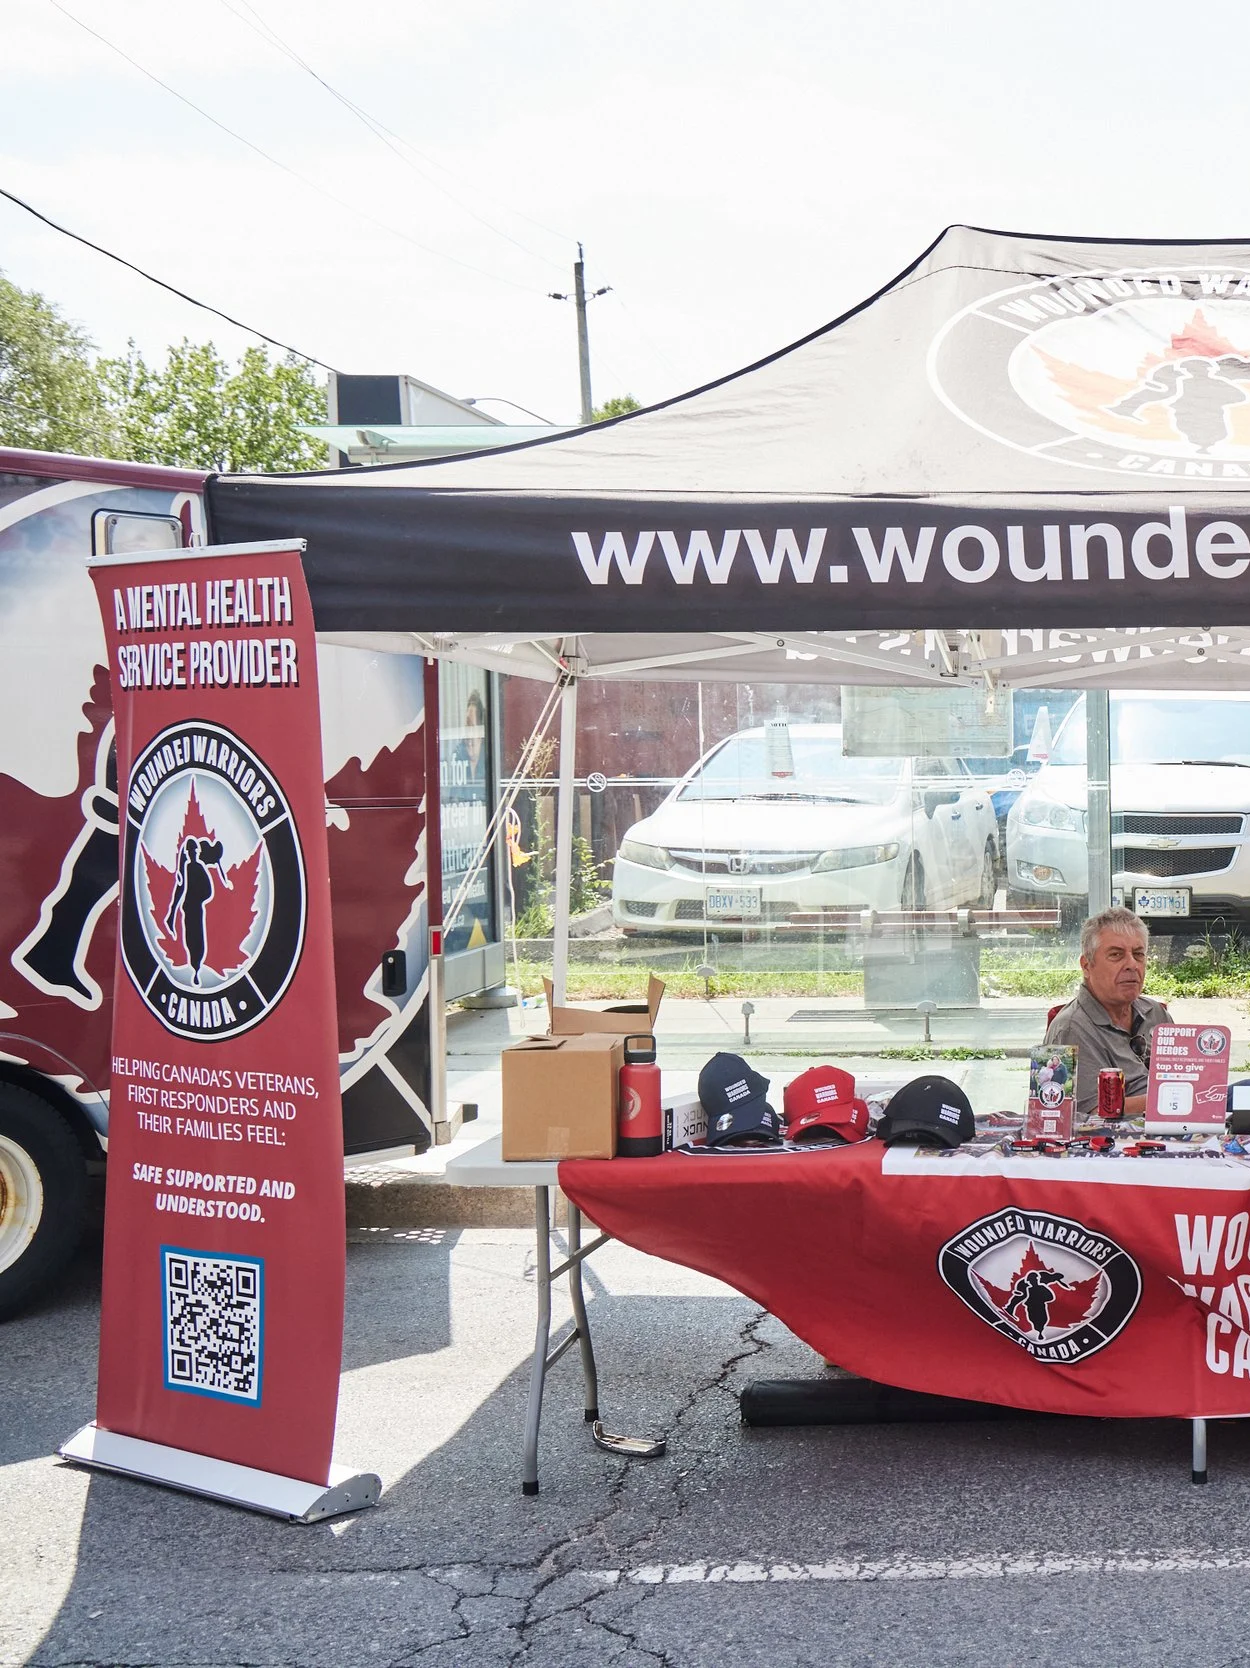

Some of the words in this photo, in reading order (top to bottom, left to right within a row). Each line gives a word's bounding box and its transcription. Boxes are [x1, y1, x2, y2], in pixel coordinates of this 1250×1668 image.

[1002, 273, 1184, 325] WOUNDED
[113, 588, 127, 631] A
[126, 581, 202, 630] MENTAL
[205, 576, 292, 625] HEALTH
[117, 641, 187, 688] SERVICE
[189, 637, 299, 685] PROVIDER
[128, 735, 191, 813] WOUNDED
[192, 734, 277, 820] WARRIORS
[167, 991, 236, 1029] CANADA
[1156, 1045, 1189, 1056] HEROES
[1157, 1037, 1175, 1046] OUR
[1158, 1027, 1197, 1037] SUPPORT
[112, 1056, 160, 1080] HELPING
[161, 1063, 233, 1089] CANADA'S
[235, 1071, 319, 1099] VETERANS,
[1156, 1063, 1172, 1071] tap
[1174, 1063, 1183, 1071] to
[1185, 1063, 1204, 1072] give
[128, 1084, 159, 1106] FIRST
[160, 1091, 259, 1116] RESPONDERS
[263, 1099, 296, 1121] AND
[137, 1111, 172, 1135] THEIR
[176, 1117, 243, 1142] FAMILIES
[247, 1124, 287, 1146] FEEL:
[132, 1162, 162, 1185] SAFE
[165, 1167, 257, 1197] SUPPORTED
[260, 1177, 296, 1200] AND
[155, 1192, 266, 1223] UNDERSTOOD.
[954, 1214, 1026, 1259] WOUNDED
[1029, 1218, 1112, 1261] WARRIORS
[1017, 1337, 1081, 1360] CANADA
